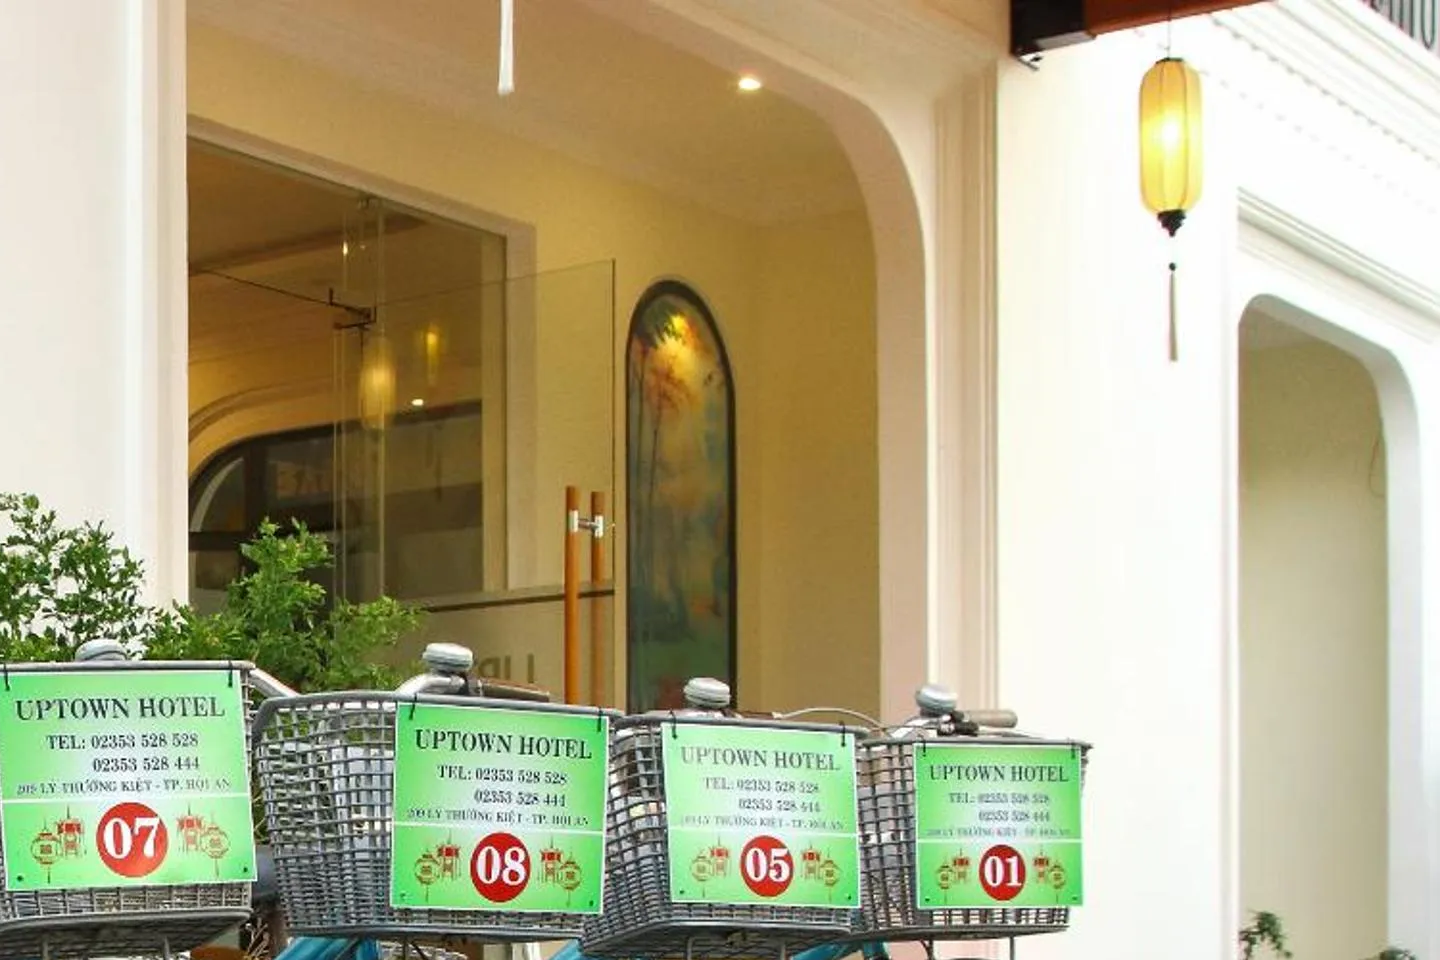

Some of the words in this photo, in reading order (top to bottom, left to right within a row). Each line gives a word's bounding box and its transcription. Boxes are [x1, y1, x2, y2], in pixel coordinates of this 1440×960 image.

[15, 697, 130, 721] UPTOWN
[138, 696, 226, 718] HOTEL
[46, 734, 86, 750] TEL:
[91, 734, 136, 749] 02353
[141, 733, 168, 748] 528
[172, 732, 199, 746] 528
[415, 729, 512, 754] UPTOWN
[518, 736, 592, 759] HOTEL
[92, 757, 138, 772] 02353
[142, 756, 169, 771] 528
[173, 756, 200, 770] 444
[681, 746, 767, 768] UPTOWN
[773, 753, 840, 771] HOTEL
[437, 765, 471, 781] TEL:
[475, 767, 513, 783] 02353
[518, 770, 540, 784] 528
[544, 771, 568, 786] 528
[930, 765, 1005, 782] UPTOWN
[1011, 765, 1069, 782] HOTEL
[103, 816, 160, 860] 07
[476, 845, 526, 886] 08
[744, 846, 790, 882] 05
[984, 855, 1022, 887] 01
